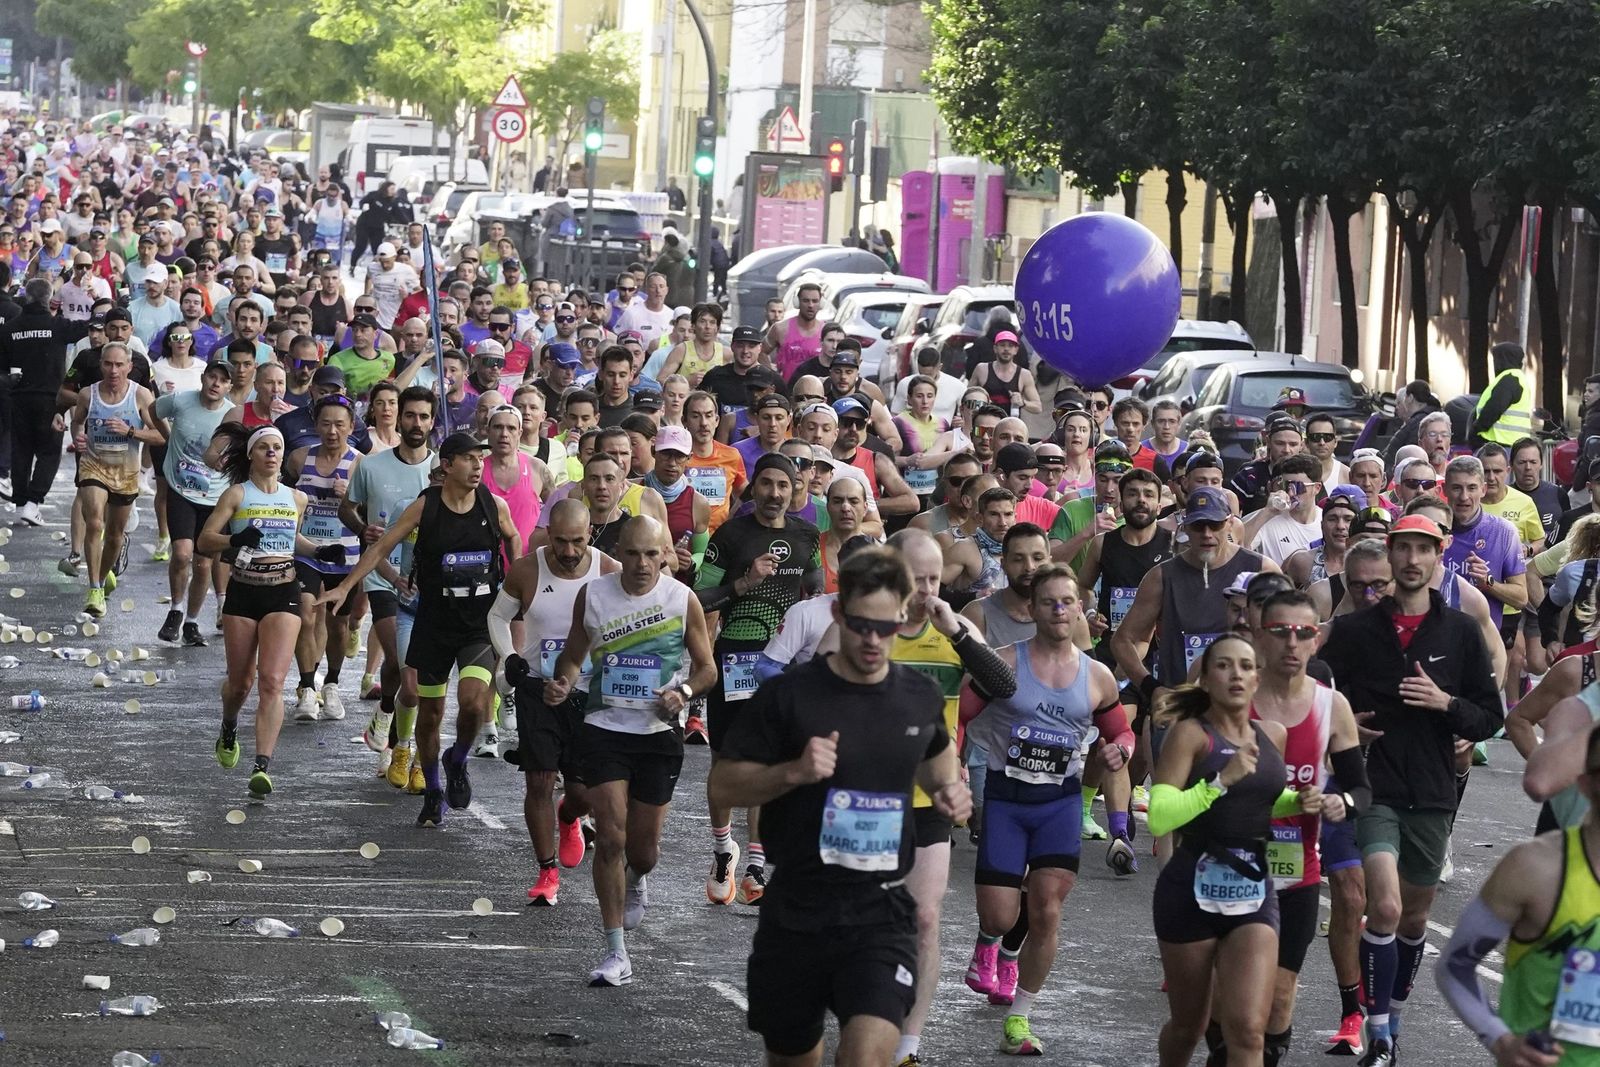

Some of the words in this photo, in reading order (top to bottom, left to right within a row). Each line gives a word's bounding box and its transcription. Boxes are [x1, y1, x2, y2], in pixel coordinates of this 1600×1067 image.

[499, 119, 520, 132] 30
[1032, 300, 1074, 342] 3:15
[11, 329, 53, 341] VOLUNTEER
[314, 510, 338, 518] ZURICH
[1502, 510, 1520, 519] BCN
[307, 527, 335, 537] LONNIE
[459, 554, 486, 562] ZURICH
[599, 604, 663, 634] SANTIAGO
[602, 625, 633, 642] CORIA
[634, 612, 666, 630] STEEL
[621, 656, 655, 667] ZURICH
[621, 672, 639, 682] 8399
[611, 682, 649, 697] PEPIPE
[1035, 701, 1065, 717] ANR
[1033, 731, 1069, 745] ZURICH
[1031, 747, 1051, 758] 5154
[1018, 756, 1057, 772] GORKA
[1272, 830, 1297, 840] RICH
[821, 834, 859, 852] MARC
[1201, 883, 1260, 899] REBECCA
